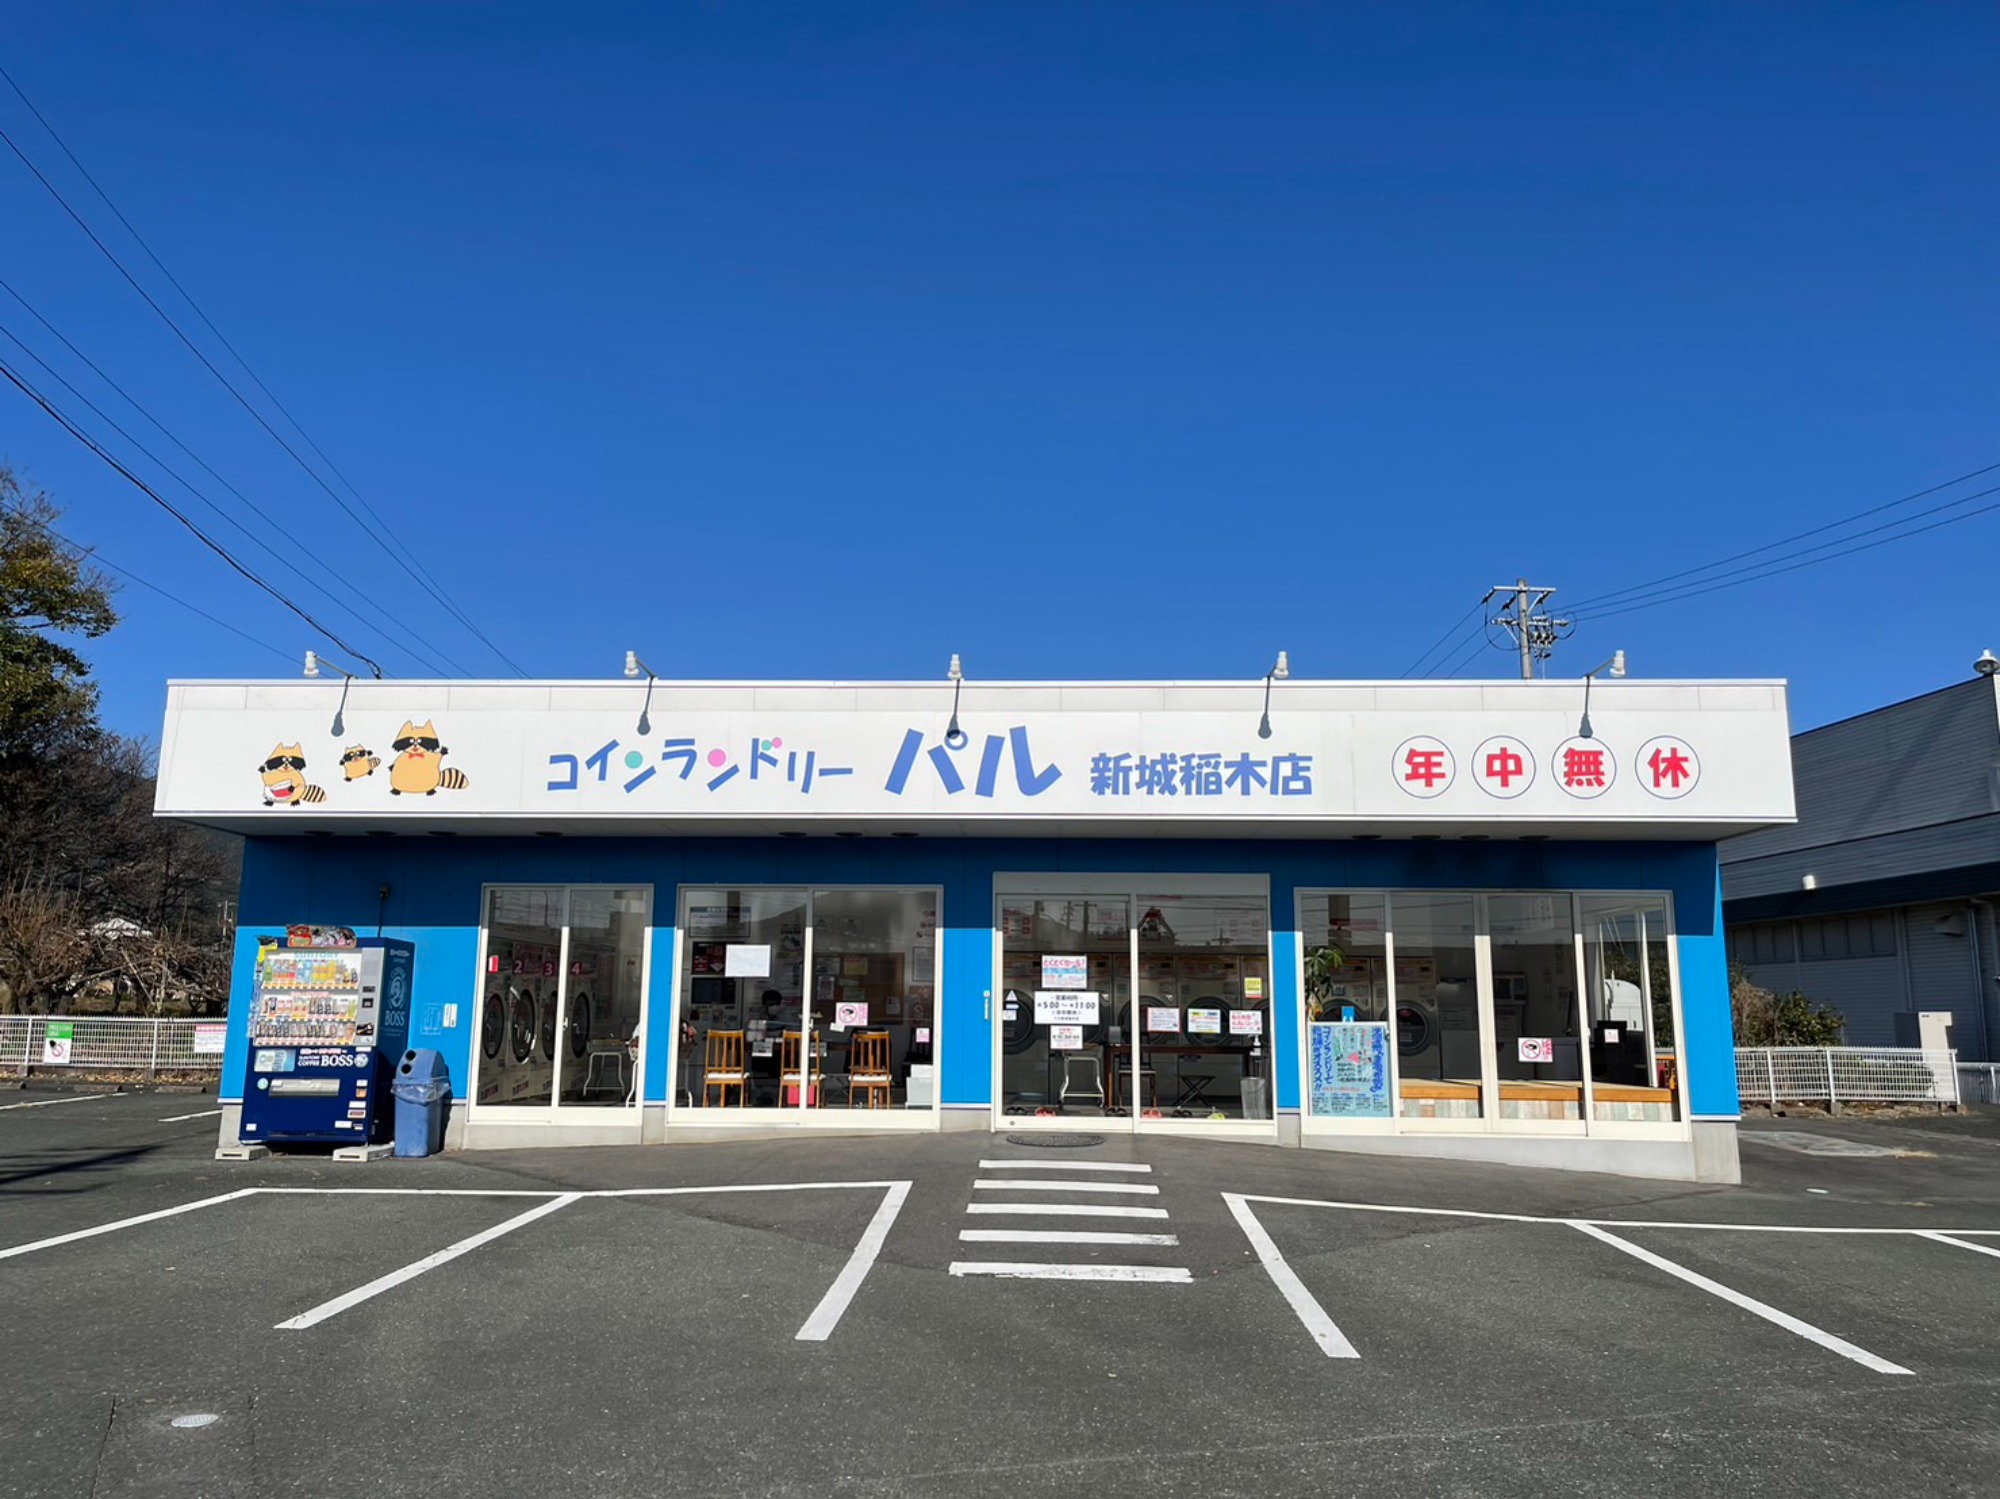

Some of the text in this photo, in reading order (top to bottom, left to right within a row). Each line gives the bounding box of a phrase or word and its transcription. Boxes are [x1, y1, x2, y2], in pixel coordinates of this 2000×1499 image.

[547, 726, 1314, 798] コインランドリー パル 新城稲木店
[513, 961, 523, 973] 2
[544, 963, 553, 976] 3
[571, 963, 580, 975] 4
[384, 1010, 406, 1027] BOSS
[321, 1054, 354, 1067] BOSS
